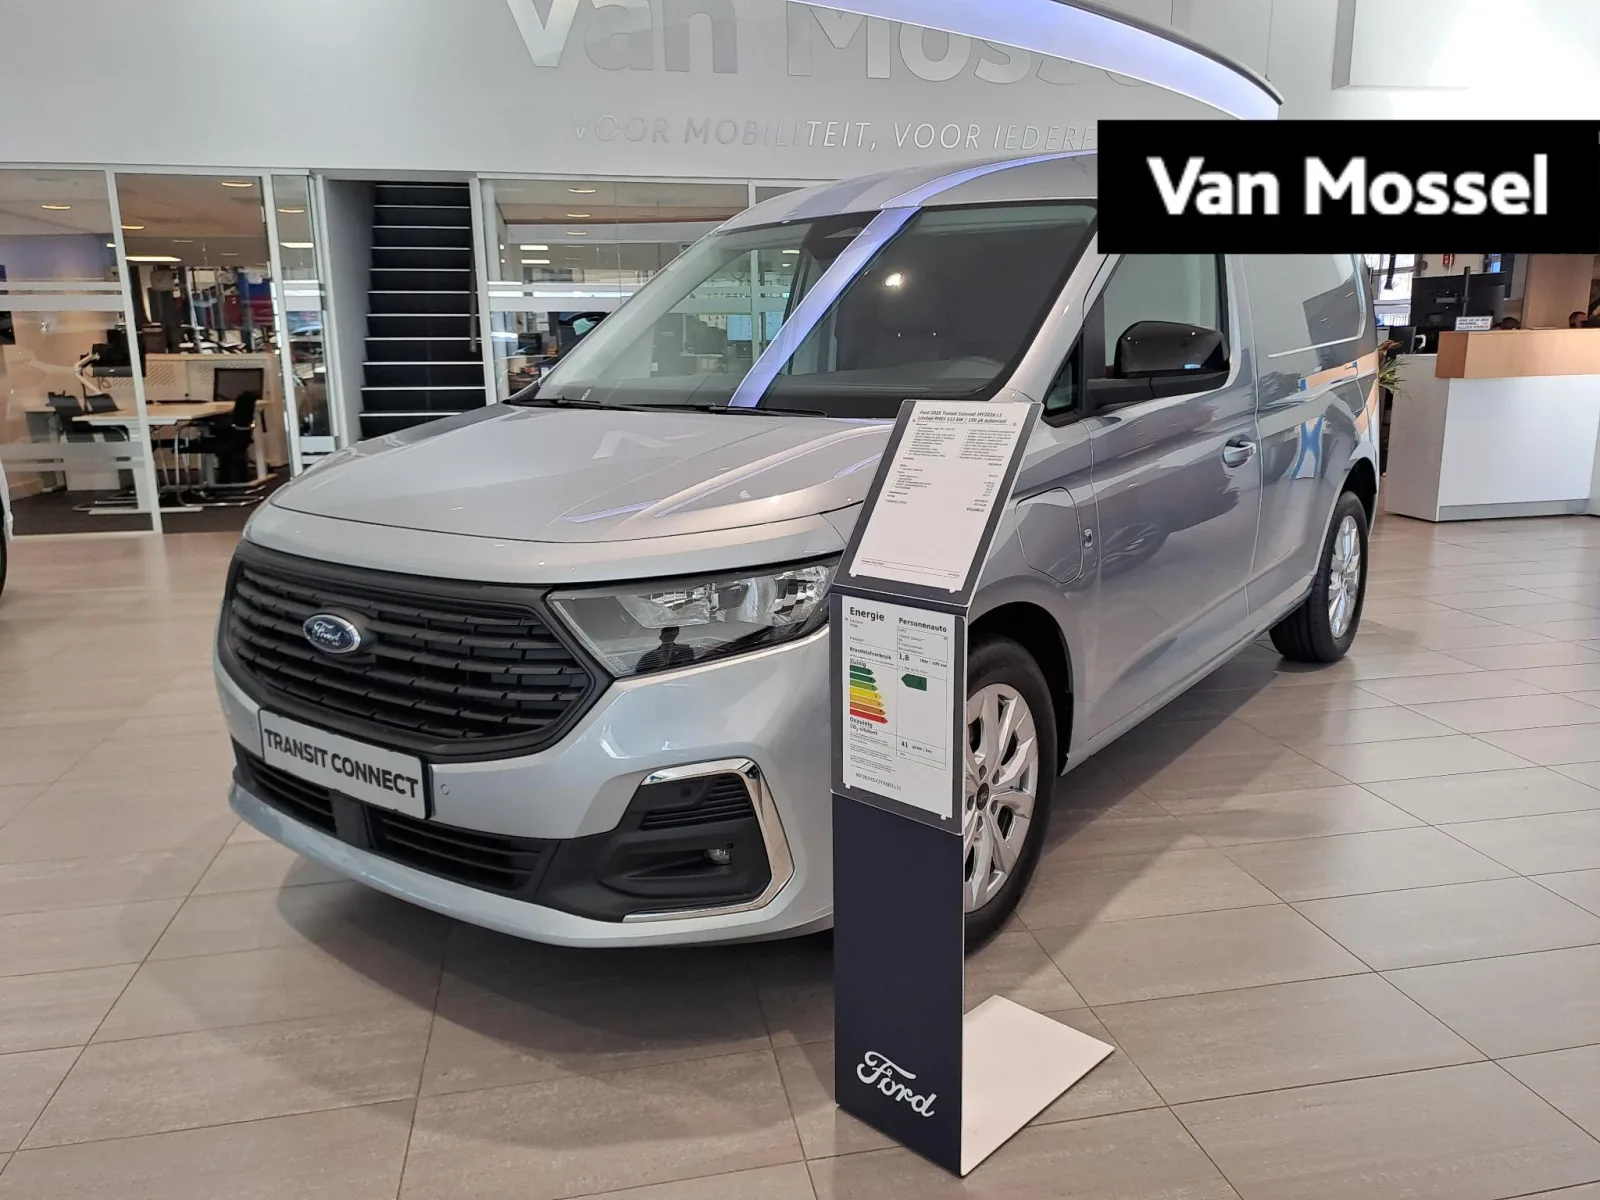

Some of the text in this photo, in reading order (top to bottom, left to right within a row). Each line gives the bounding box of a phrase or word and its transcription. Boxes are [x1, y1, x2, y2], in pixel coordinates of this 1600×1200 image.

[571, 113, 669, 144] VOOR
[684, 116, 878, 152] MOBILITEIT,
[894, 122, 981, 149] VOOR
[850, 606, 885, 622] Energie
[898, 617, 947, 633] Personenauto
[849, 657, 867, 669] Zuinig
[898, 653, 910, 662] 1,8
[901, 740, 908, 749] 41
[263, 727, 419, 798] TRANSIT CONNECT
[856, 1050, 938, 1118] Ford
